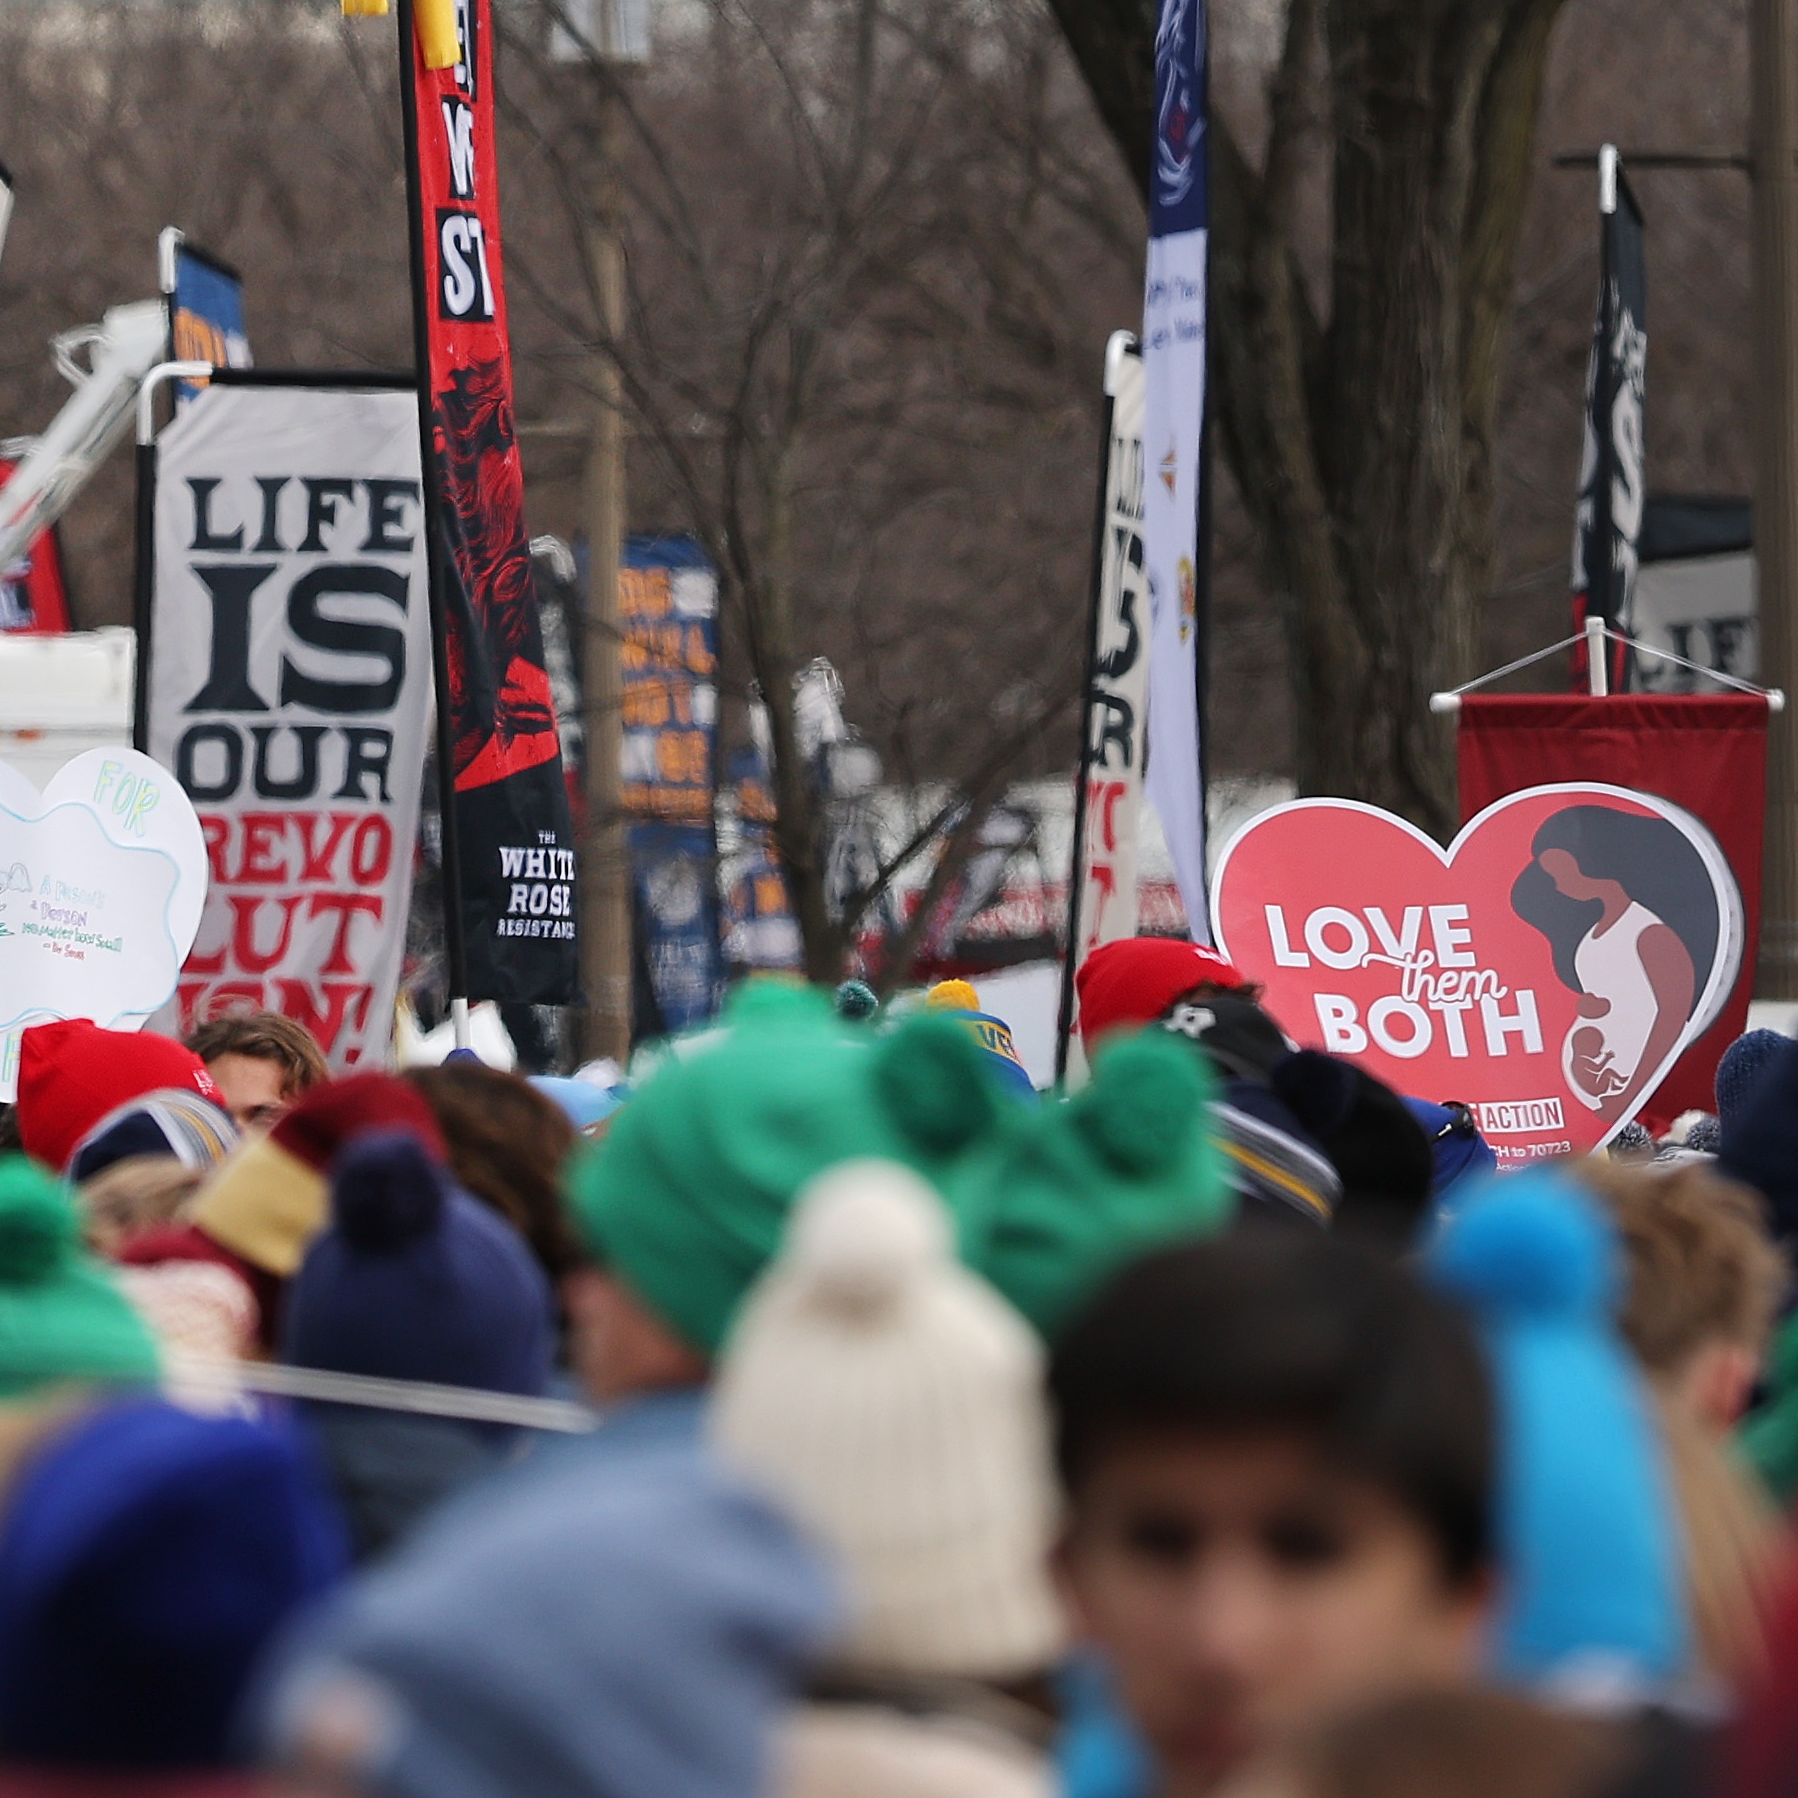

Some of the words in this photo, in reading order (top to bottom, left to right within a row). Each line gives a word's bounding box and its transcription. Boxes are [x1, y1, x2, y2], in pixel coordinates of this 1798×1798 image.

[184, 475, 421, 553] LIFE
[181, 562, 411, 715] IS
[177, 723, 393, 803] OUR
[1264, 904, 1477, 970] LOVE
[1361, 951, 1507, 1003] them
[1314, 989, 1544, 1058] BOTH
[1486, 1101, 1561, 1130] ACTION
[1511, 1147, 1526, 1158] to
[1527, 1141, 1572, 1157] 70723
